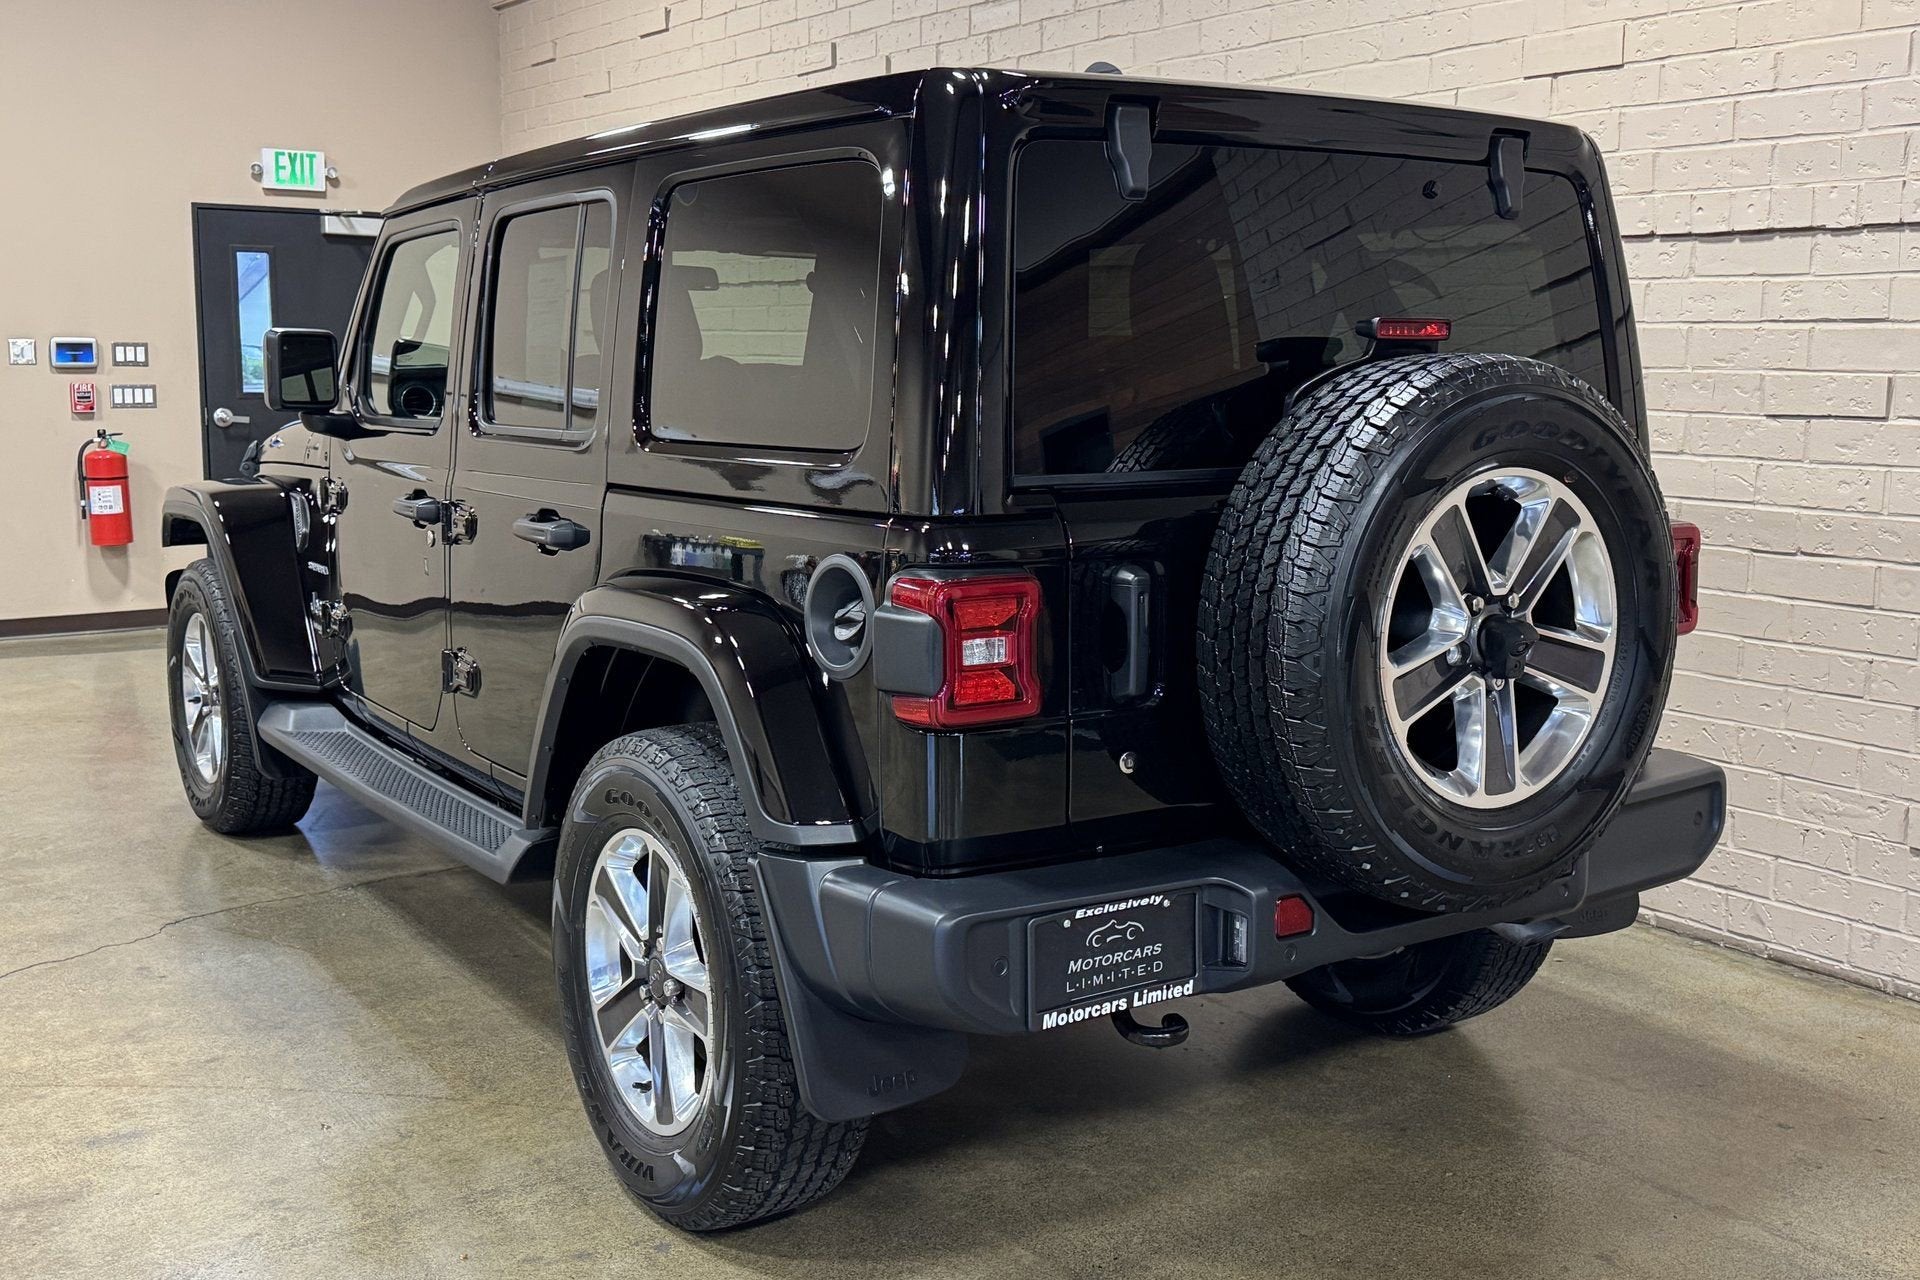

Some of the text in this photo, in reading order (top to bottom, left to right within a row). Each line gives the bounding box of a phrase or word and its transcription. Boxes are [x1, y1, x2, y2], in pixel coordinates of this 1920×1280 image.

[274, 150, 317, 186] EXIT
[1074, 895, 1164, 919] Exclusively
[1067, 943, 1163, 974] MOTORCARS
[1042, 979, 1194, 1030] Motorcars Limited
